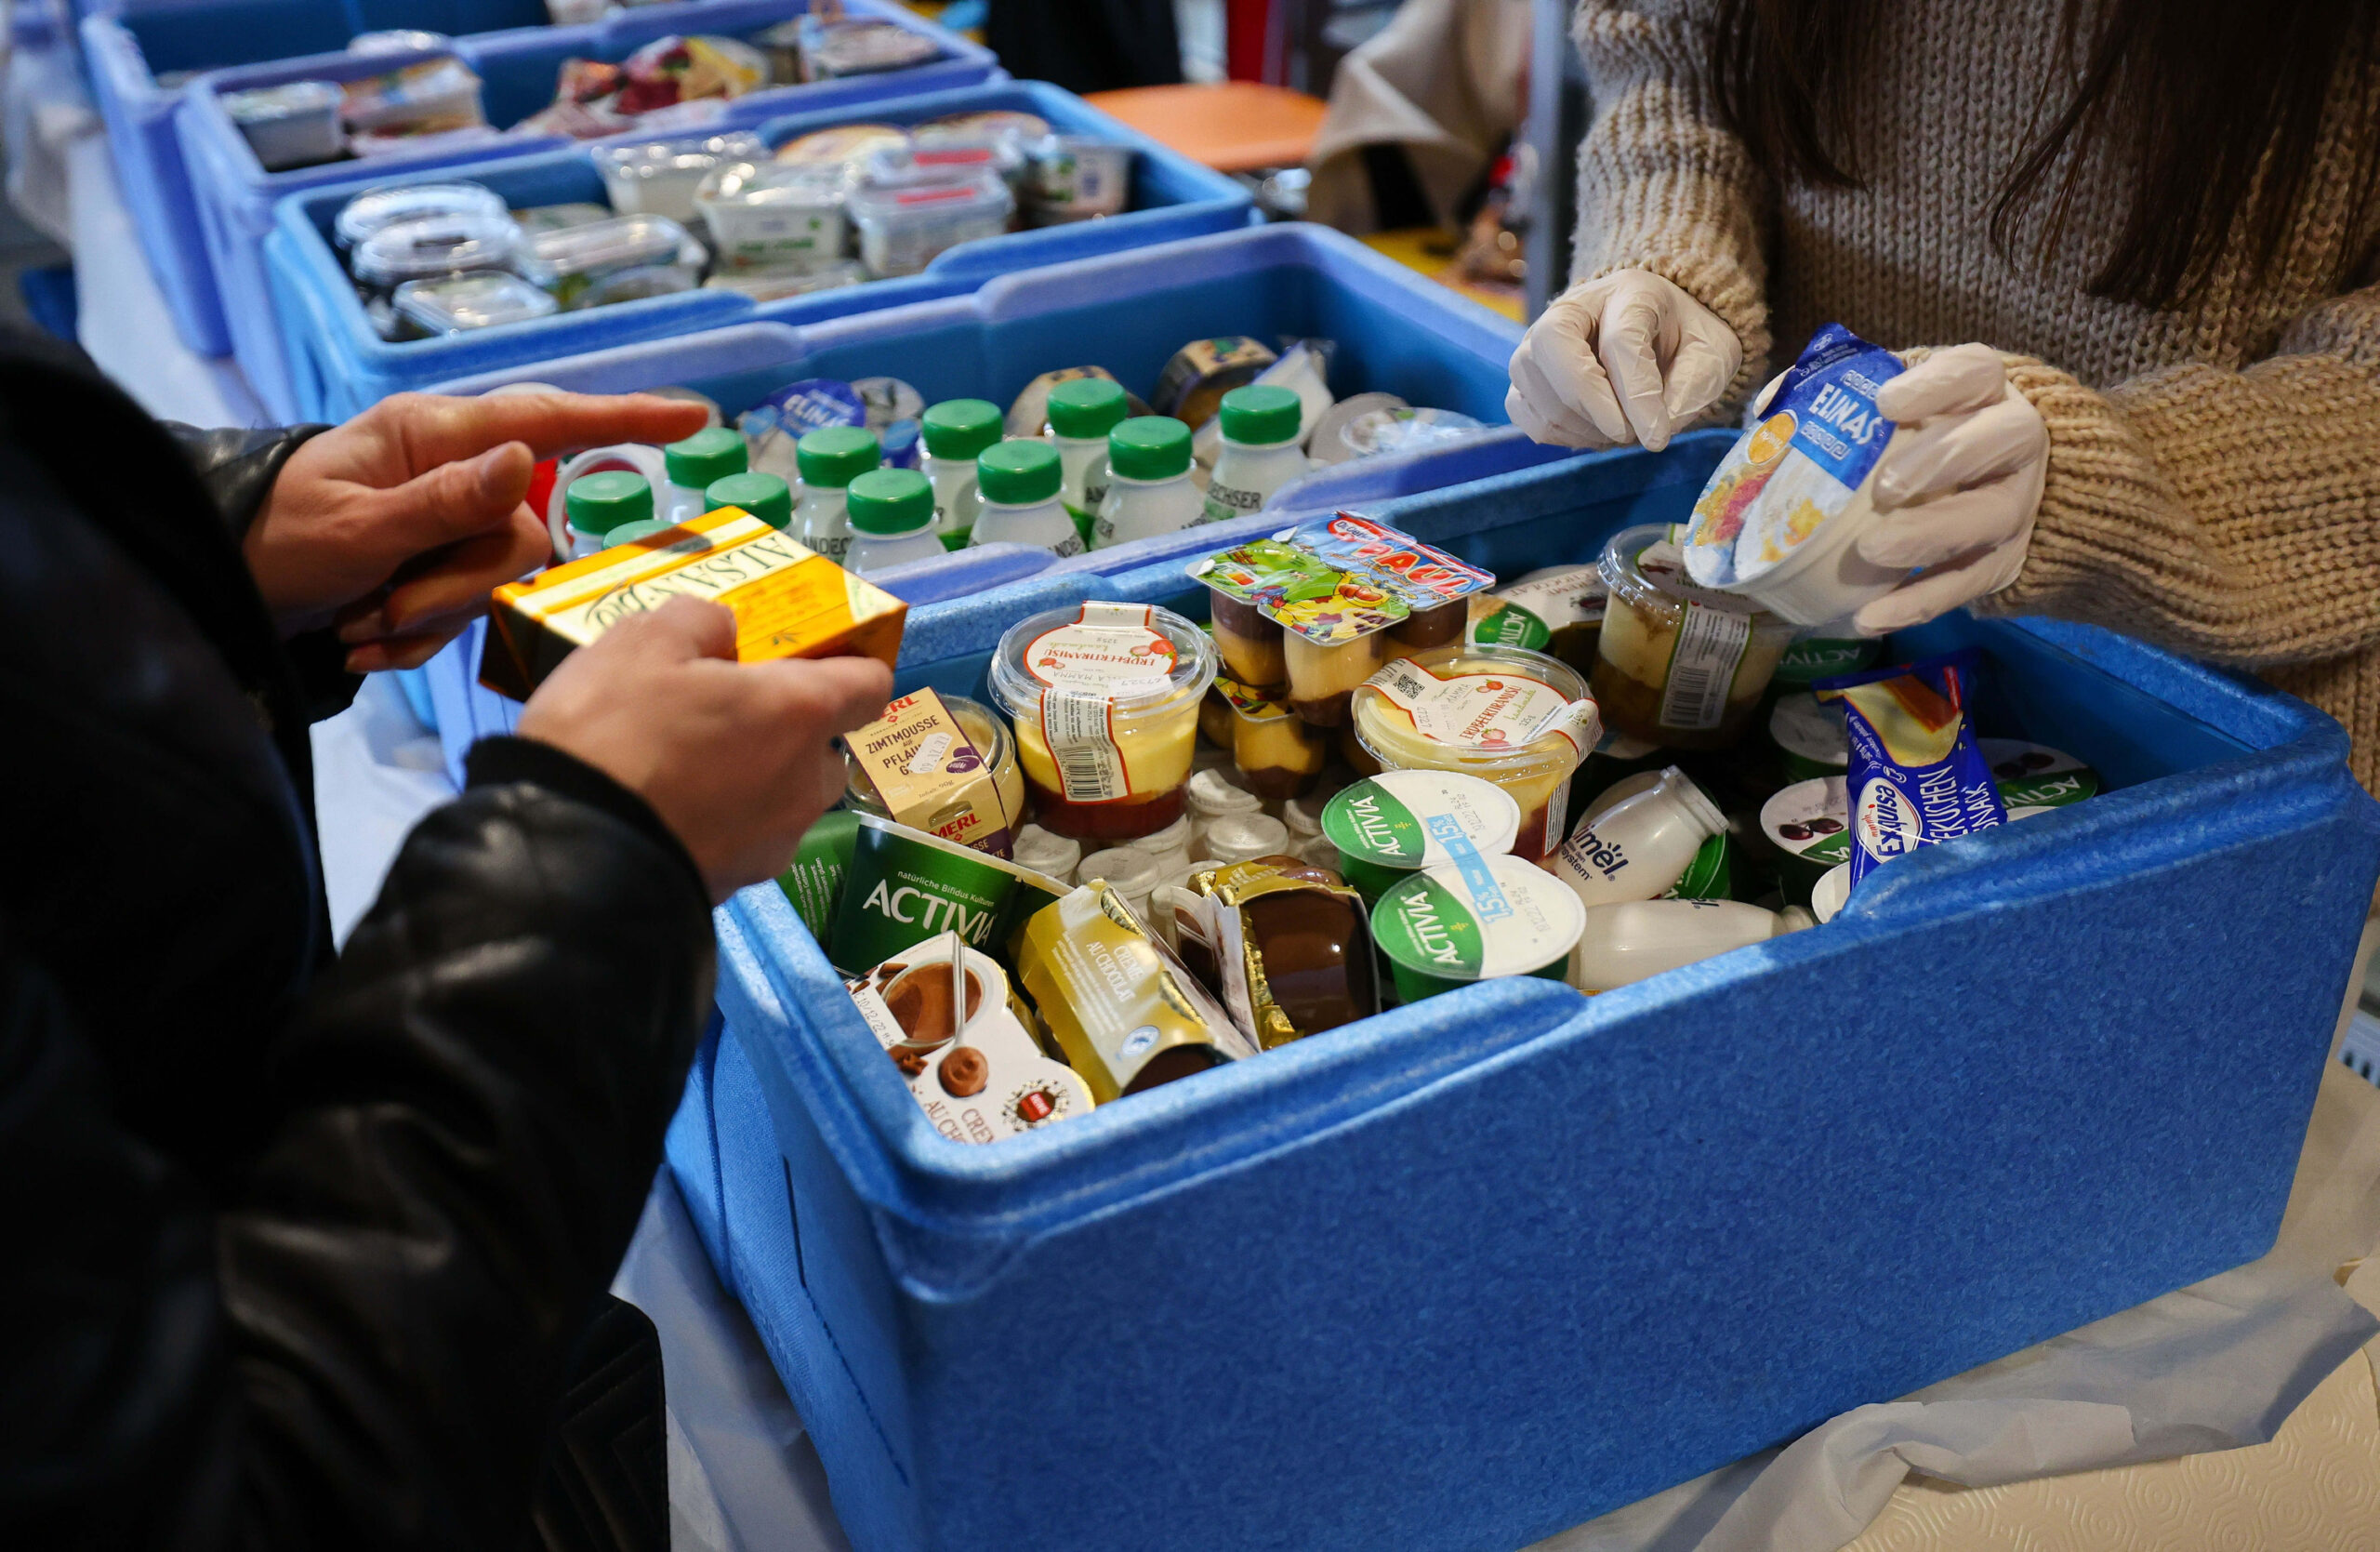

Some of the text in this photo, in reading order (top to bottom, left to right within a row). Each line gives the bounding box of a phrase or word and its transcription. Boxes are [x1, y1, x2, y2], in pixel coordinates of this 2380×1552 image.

[1808, 383, 1884, 444] ELINAS
[1497, 610, 1527, 648] ACTIV
[1778, 646, 1862, 667] ACTIV
[880, 696, 919, 719] ERL
[1919, 764, 1969, 839] EKUCHEN
[2001, 775, 2082, 809] ACTIV
[1359, 795, 1407, 858] ACTIVIA
[1875, 784, 1909, 856] Exquisa
[897, 870, 940, 891] natürliche
[941, 883, 970, 900] Bifidus
[863, 879, 998, 948] ACTIVIA
[1411, 891, 1464, 966] ACTIVIA
[1085, 938, 1106, 960] AU
[1112, 943, 1144, 982] CREME
[1094, 953, 1136, 1004] CHOCOLAT
[924, 1097, 948, 1122] AU
